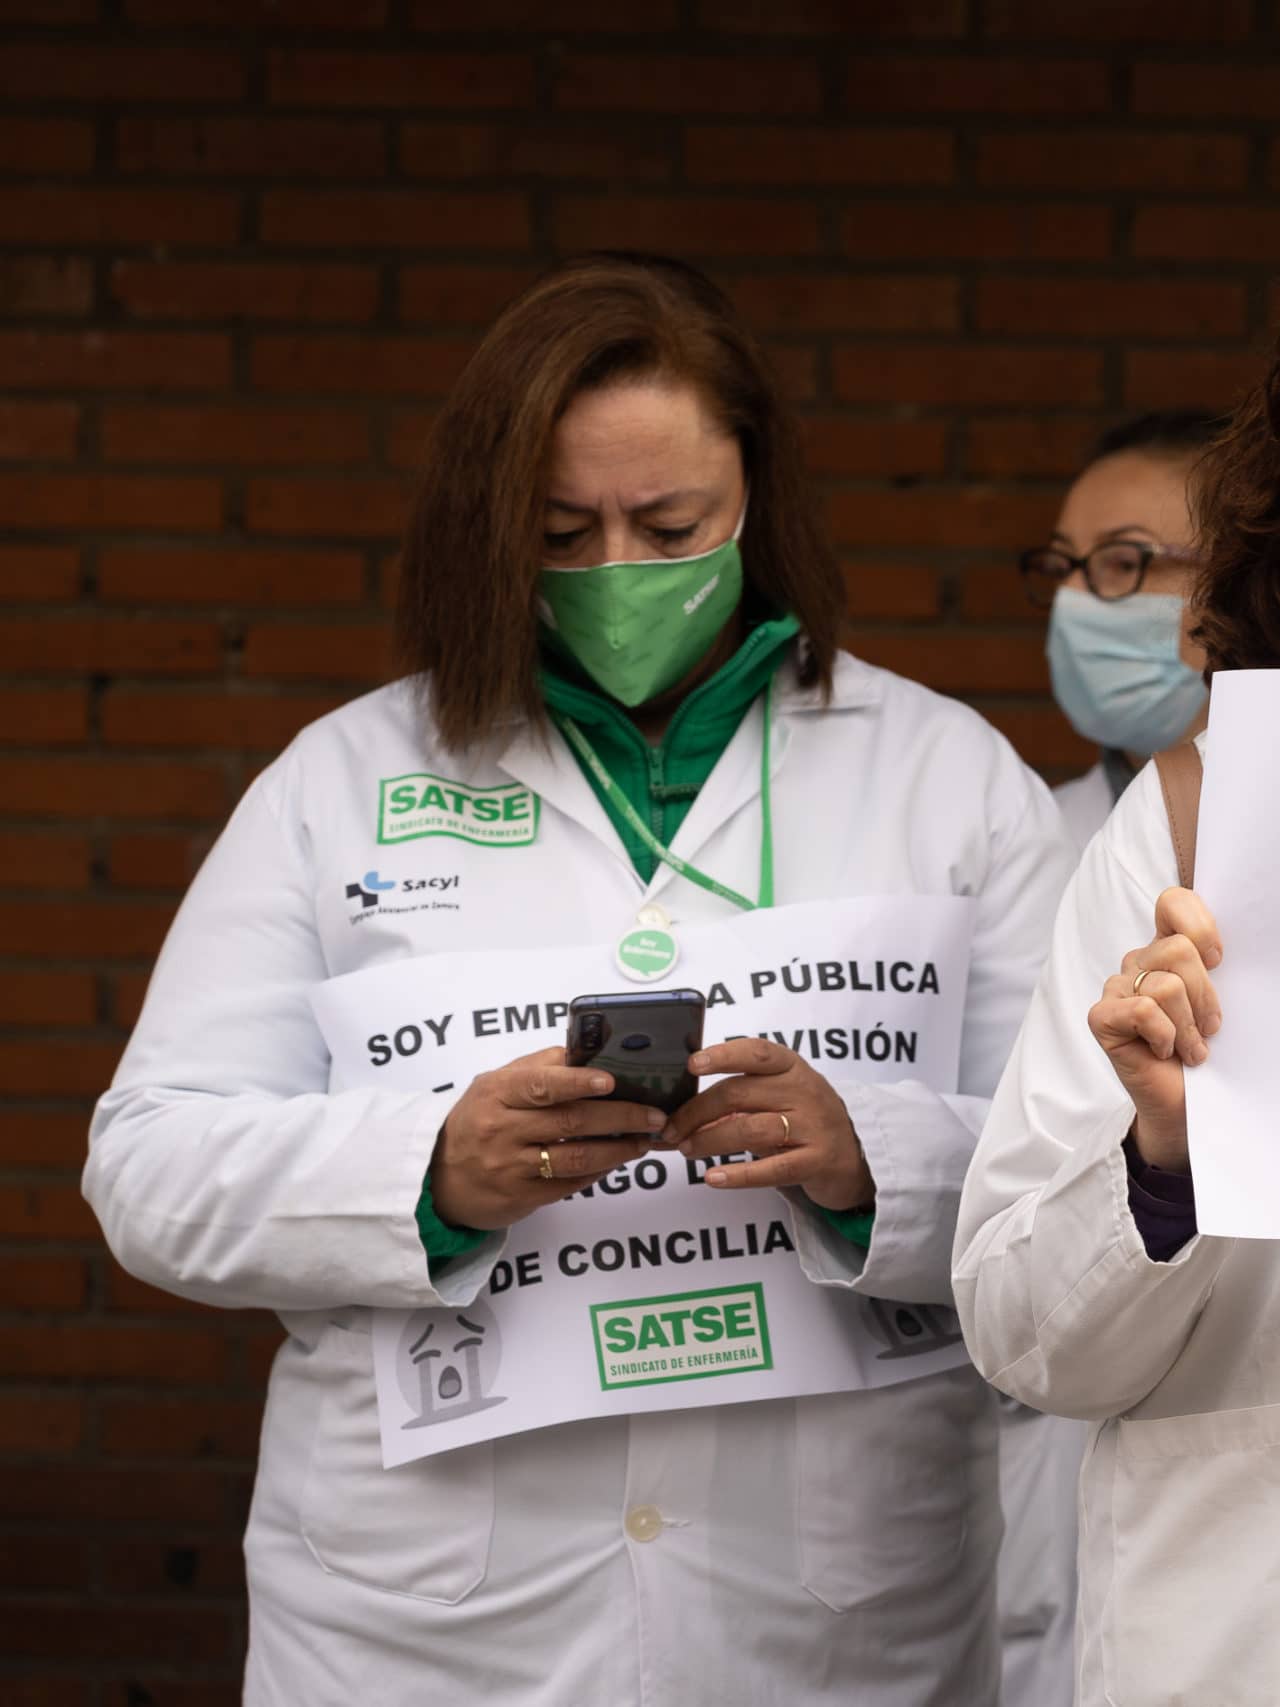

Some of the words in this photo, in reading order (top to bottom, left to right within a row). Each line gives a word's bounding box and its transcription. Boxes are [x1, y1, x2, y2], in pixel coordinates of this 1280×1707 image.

[389, 784, 530, 822] SATSE
[367, 1014, 453, 1067] SOY
[750, 957, 940, 998] PÚBLICA
[724, 1022, 918, 1063] VISIÓN
[489, 1252, 543, 1296] DE
[558, 1220, 796, 1277] CONCILIA
[604, 1302, 756, 1353] SATSE
[610, 1358, 667, 1376] SINDICATO
[671, 1357, 684, 1370] DE
[688, 1346, 758, 1367] ENFERMERÍA
